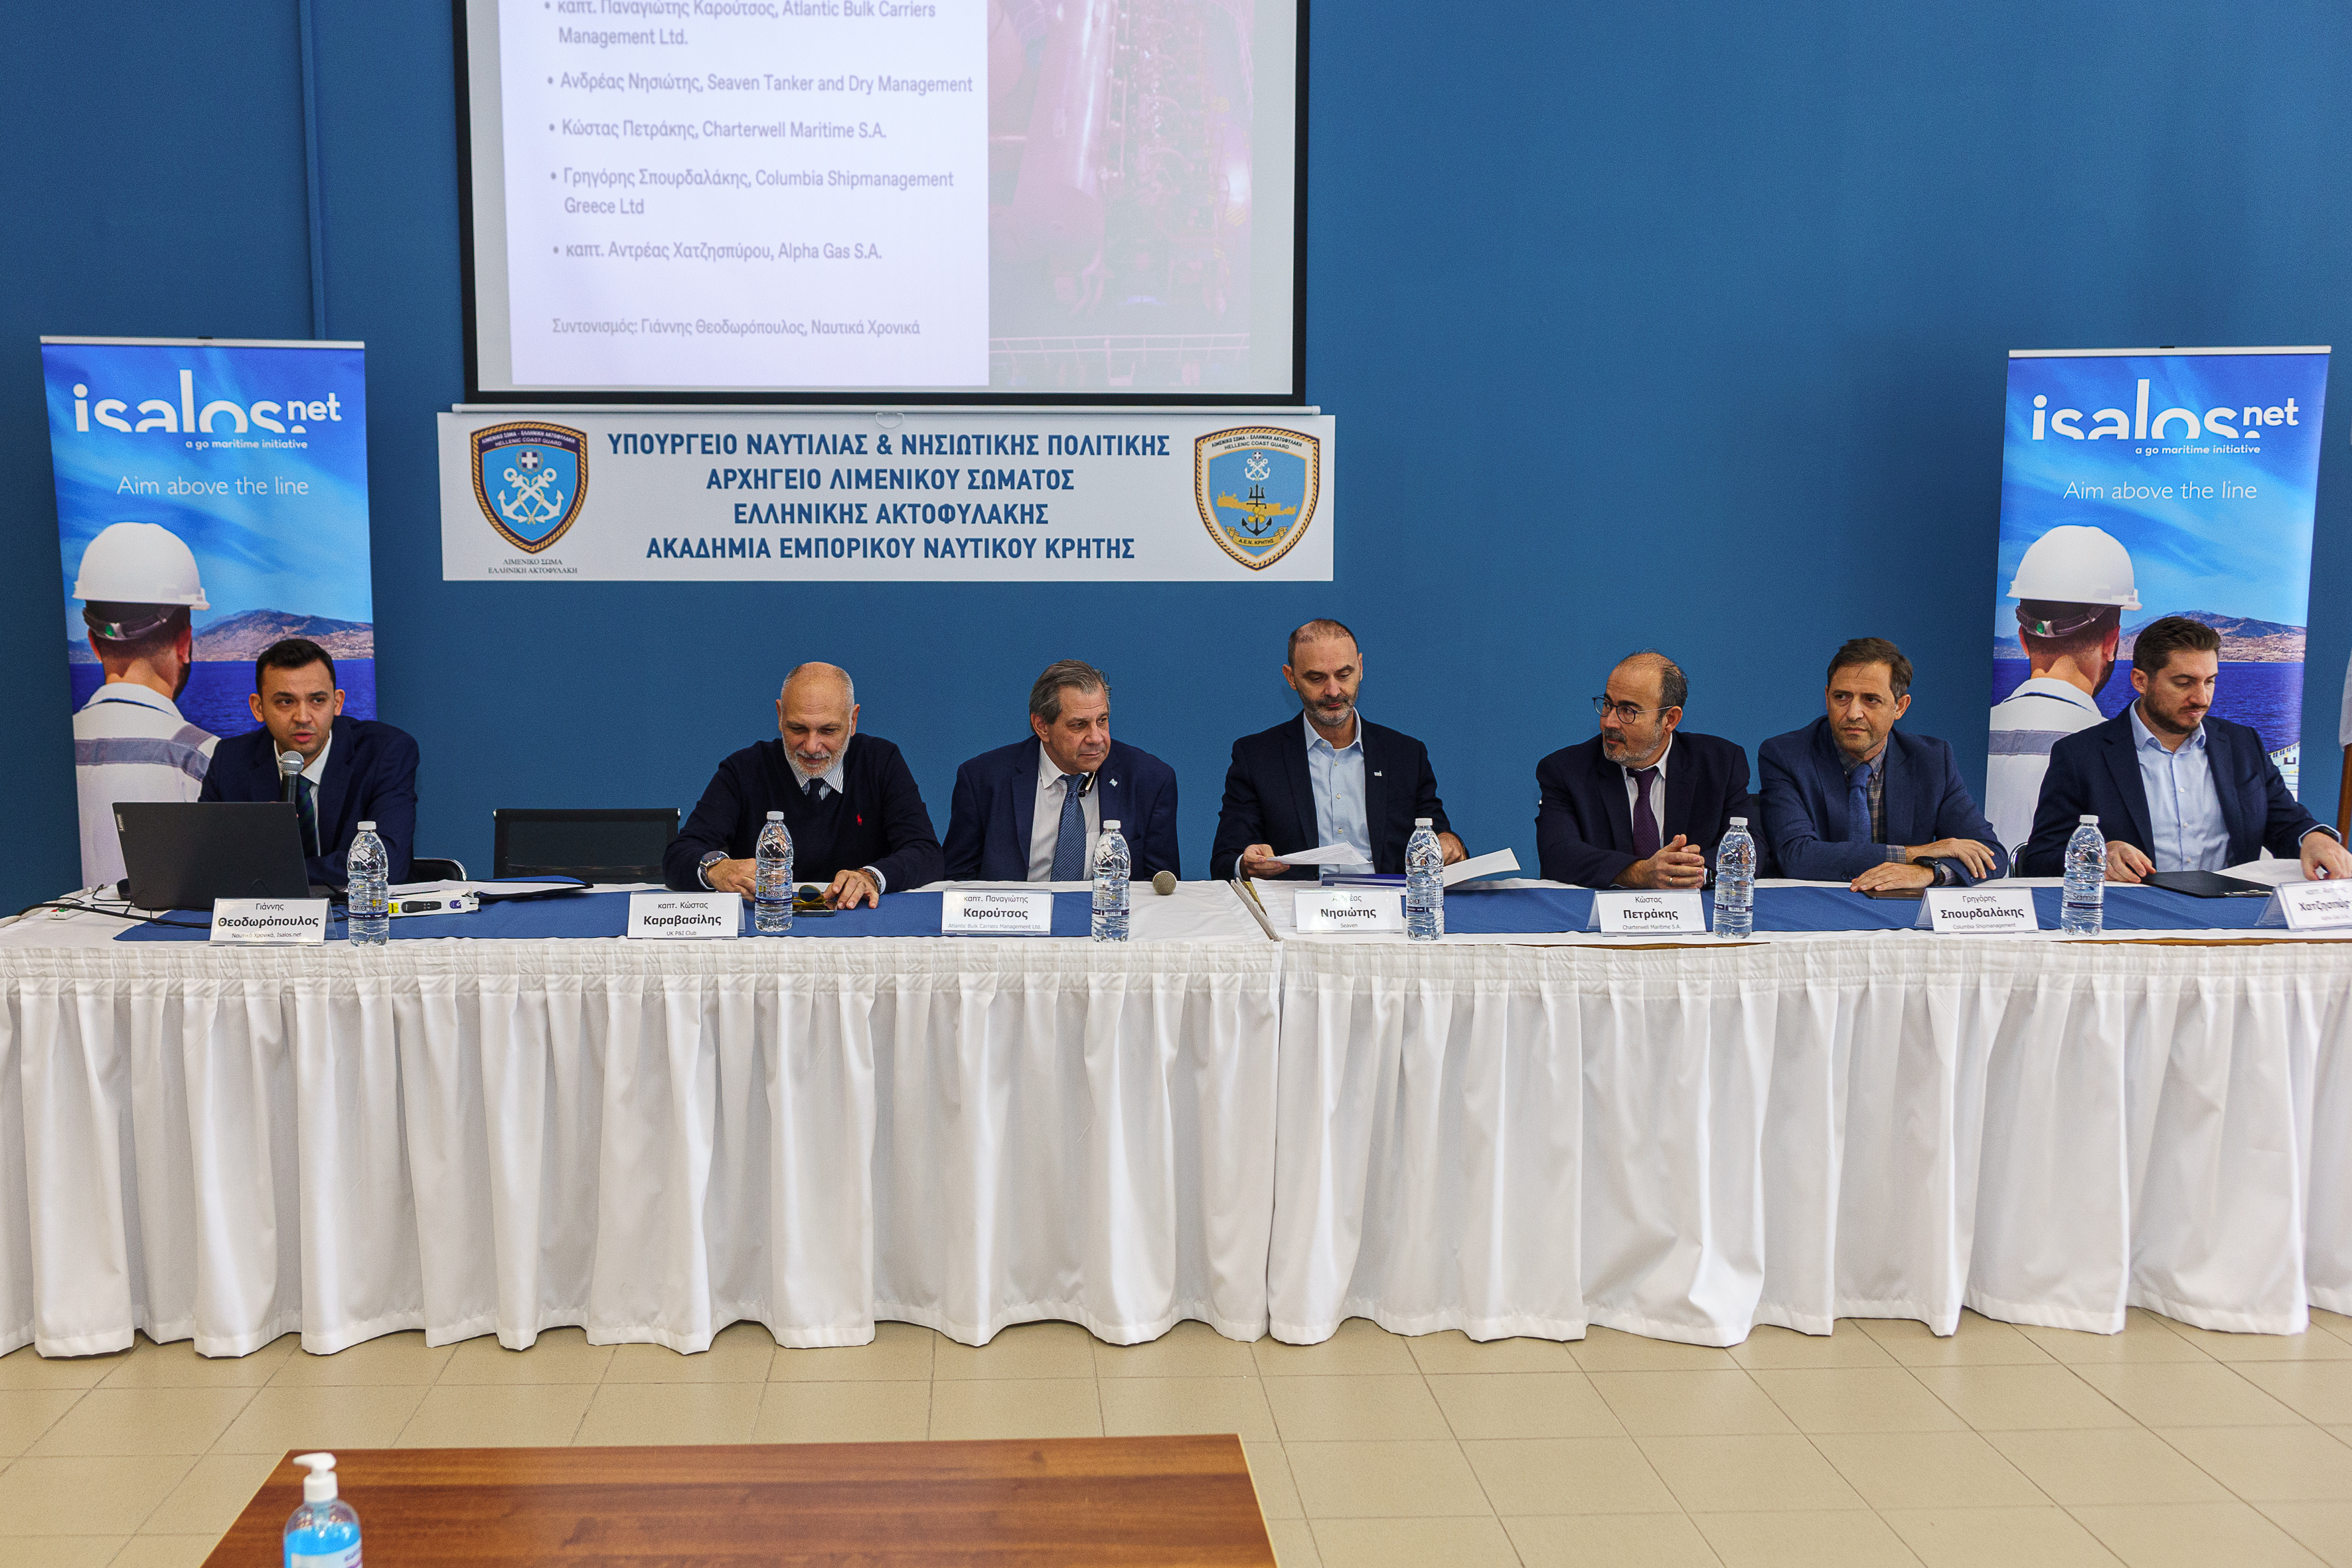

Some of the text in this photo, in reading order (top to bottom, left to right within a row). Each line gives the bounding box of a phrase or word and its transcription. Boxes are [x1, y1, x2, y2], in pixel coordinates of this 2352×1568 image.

[558, 0, 935, 19] καπτ. Παναγιώτης Καρούτσος, Atlantic Bulk Carriers
[559, 27, 688, 48] Management Ltd.
[560, 72, 973, 96] Ανδρέας Νησιώτης, Seaven Tanker and Dry Management
[562, 119, 886, 140] Κώστας Πετράκης, Charterwell Maritime S.A.
[564, 167, 953, 191] Γρηγόρης Σπουρδαλάκης, Columbia Shipmanagement
[564, 196, 644, 214] Greece Ltd
[566, 241, 882, 262] καπτ. Αντρέας Χατζησπύρου, Alpha Gas S.A.
[552, 318, 920, 337] Συντονισμός: Γιάννης Θεοδωρόπουλος, Ναυτικά Χρονικά
[196, 440, 209, 451] go
[212, 439, 259, 448] maritime
[262, 439, 307, 449] initiative
[495, 437, 521, 446] HELLENIC
[608, 433, 1170, 455] ΥΠΟΥΡΓΕΙΟ ΝΑΥΤΙΛΙΑΣ & ΝΗΣΙΩΤΙΚΗΣ ΠΟΛΙΤΙΚΗΣ
[1212, 438, 1232, 447] ΛΙΜΕΝΙΚΟ
[1273, 436, 1302, 447] ΑΚΤΟΦΥΛΑΚΗ
[2136, 444, 2260, 457] a go maritime initiative
[117, 476, 309, 495] Aim above the line
[706, 469, 1074, 490] ΑΡΧΗΓΕΙΟ ΛΙΜΕΝΙΚΟΥ ΣΩΜΑΤΟΣ
[2063, 481, 2257, 499] Aim above the line
[734, 503, 1048, 524] ΕΛΛΗΝΙΚΗΣ ΑΚΤΟΦΥΛΑΚΗΣ
[647, 538, 1135, 558] ΑΚΑΔΗΜΙΑ ΕΜΠΟΡΙΚΟΥ ΝΑΥΤΙΚΟΥ ΚΡΗΤΗΣ
[1963, 895, 1996, 903] Γρηγόρης
[218, 916, 319, 928] Θεοδωρόπουλος
[644, 914, 722, 927] Καραβασίλης
[963, 907, 1028, 919] Καρούτσος
[1320, 907, 1377, 919] Νησιώτης
[1623, 909, 1678, 920] Πετράκης
[1940, 907, 2024, 919] Σπουρδαλάκης
